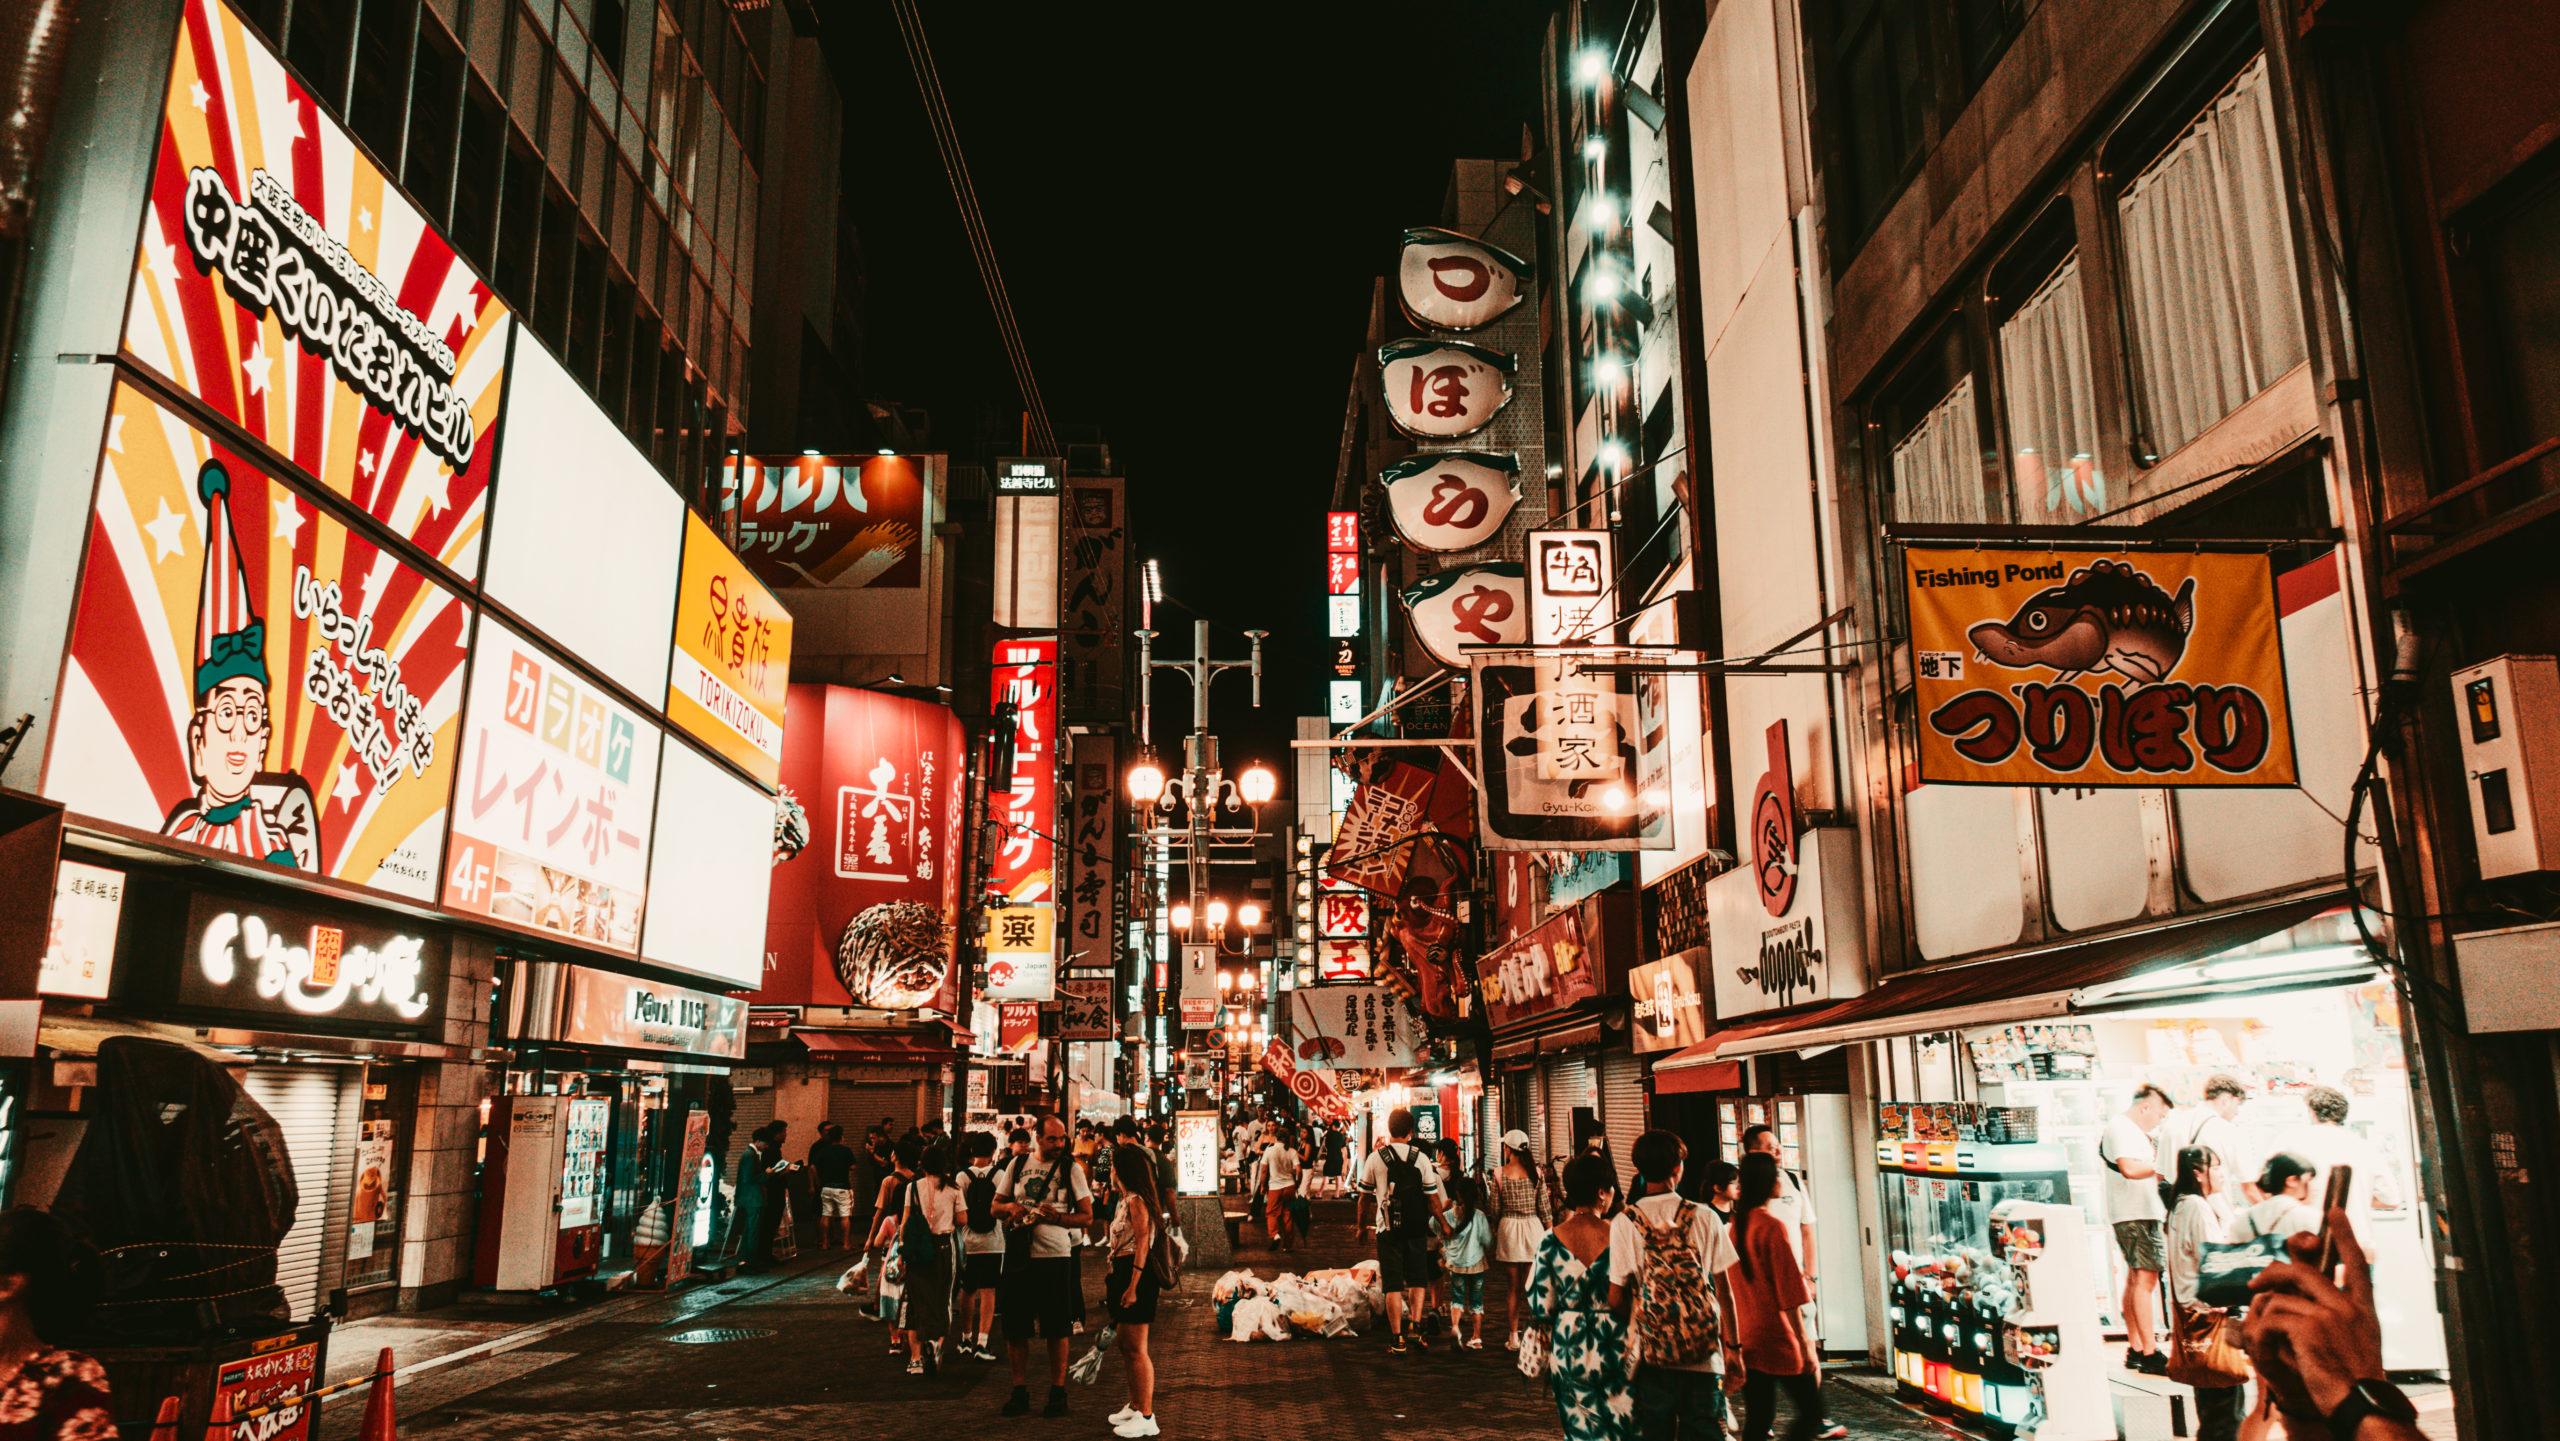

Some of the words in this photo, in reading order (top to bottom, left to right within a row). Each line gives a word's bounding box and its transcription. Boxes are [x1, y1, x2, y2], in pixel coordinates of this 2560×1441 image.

[184, 166, 475, 469] 中座くいだおれビル
[1000, 478, 1055, 489] 法善寺ビル
[1551, 551, 1596, 583] 牛角
[1915, 566, 2000, 588] Fishing
[2004, 561, 2065, 583] Pond
[703, 575, 769, 698] 鳥貴族
[295, 566, 434, 778] いらっしゃいませ
[1920, 656, 1961, 678] 地下
[511, 663, 632, 780] カラオケ
[700, 670, 764, 746] TORIKIZOKU
[1406, 722, 1448, 730] OCEAN
[1930, 682, 2269, 774] つりぼり
[471, 727, 640, 865] レインボー
[451, 846, 490, 904] 4F
[1002, 915, 1035, 947] 薬
[1115, 881, 1124, 961] TSUTAYA
[1003, 1019, 1031, 1027] ドラッグ
[1004, 1006, 1037, 1017] ツルハ
[1064, 1005, 1109, 1029] 和食
[1180, 1119, 1215, 1138] あかん
